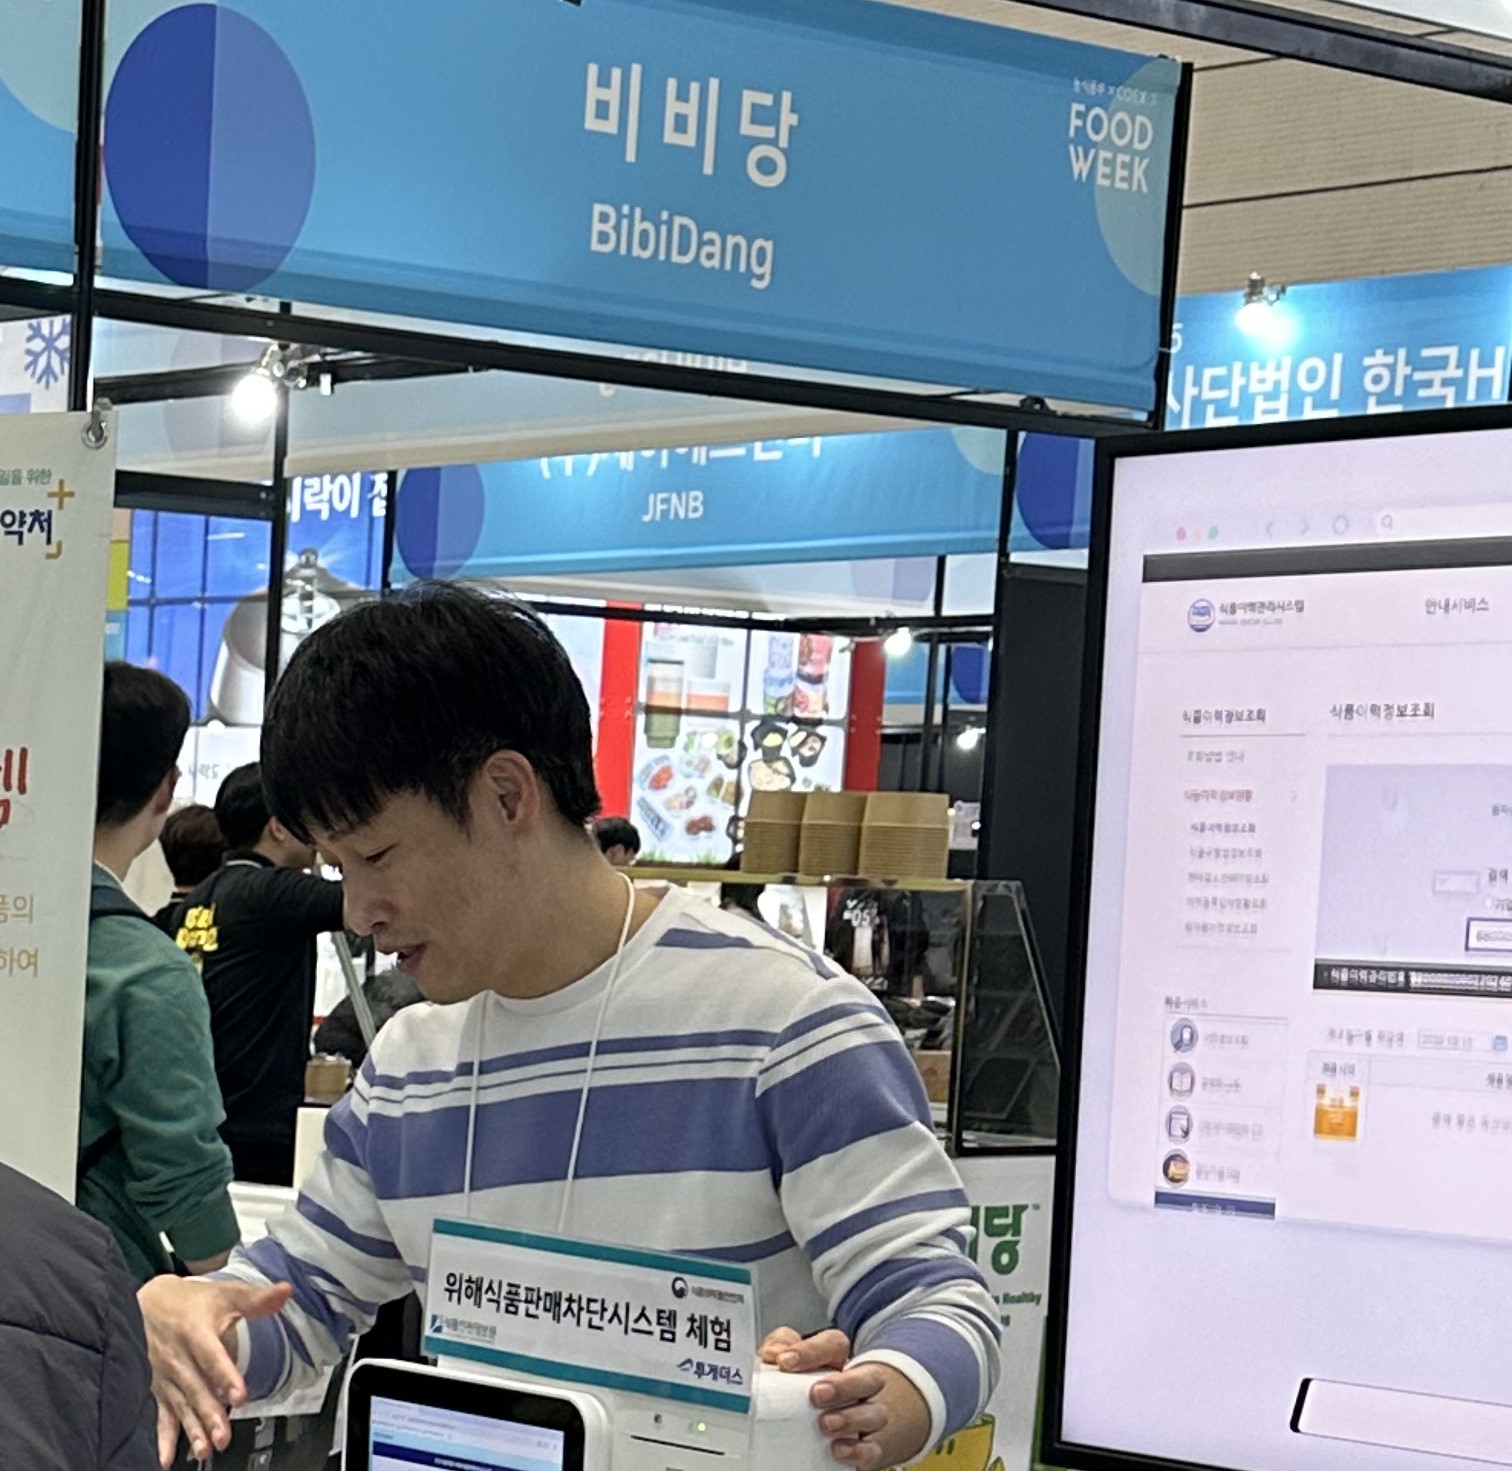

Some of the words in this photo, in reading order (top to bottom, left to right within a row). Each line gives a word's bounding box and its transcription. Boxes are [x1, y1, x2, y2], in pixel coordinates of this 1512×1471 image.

[583, 62, 799, 188] 비비당
[1068, 102, 1153, 151] FOOD
[1068, 143, 1150, 194] WEEK
[589, 201, 774, 290] BibiDang
[1167, 352, 1344, 429] 사단법인
[641, 490, 705, 522] JFNB
[443, 1271, 678, 1344] 위해식품판매차단시스템
[685, 1311, 732, 1353] 체험
